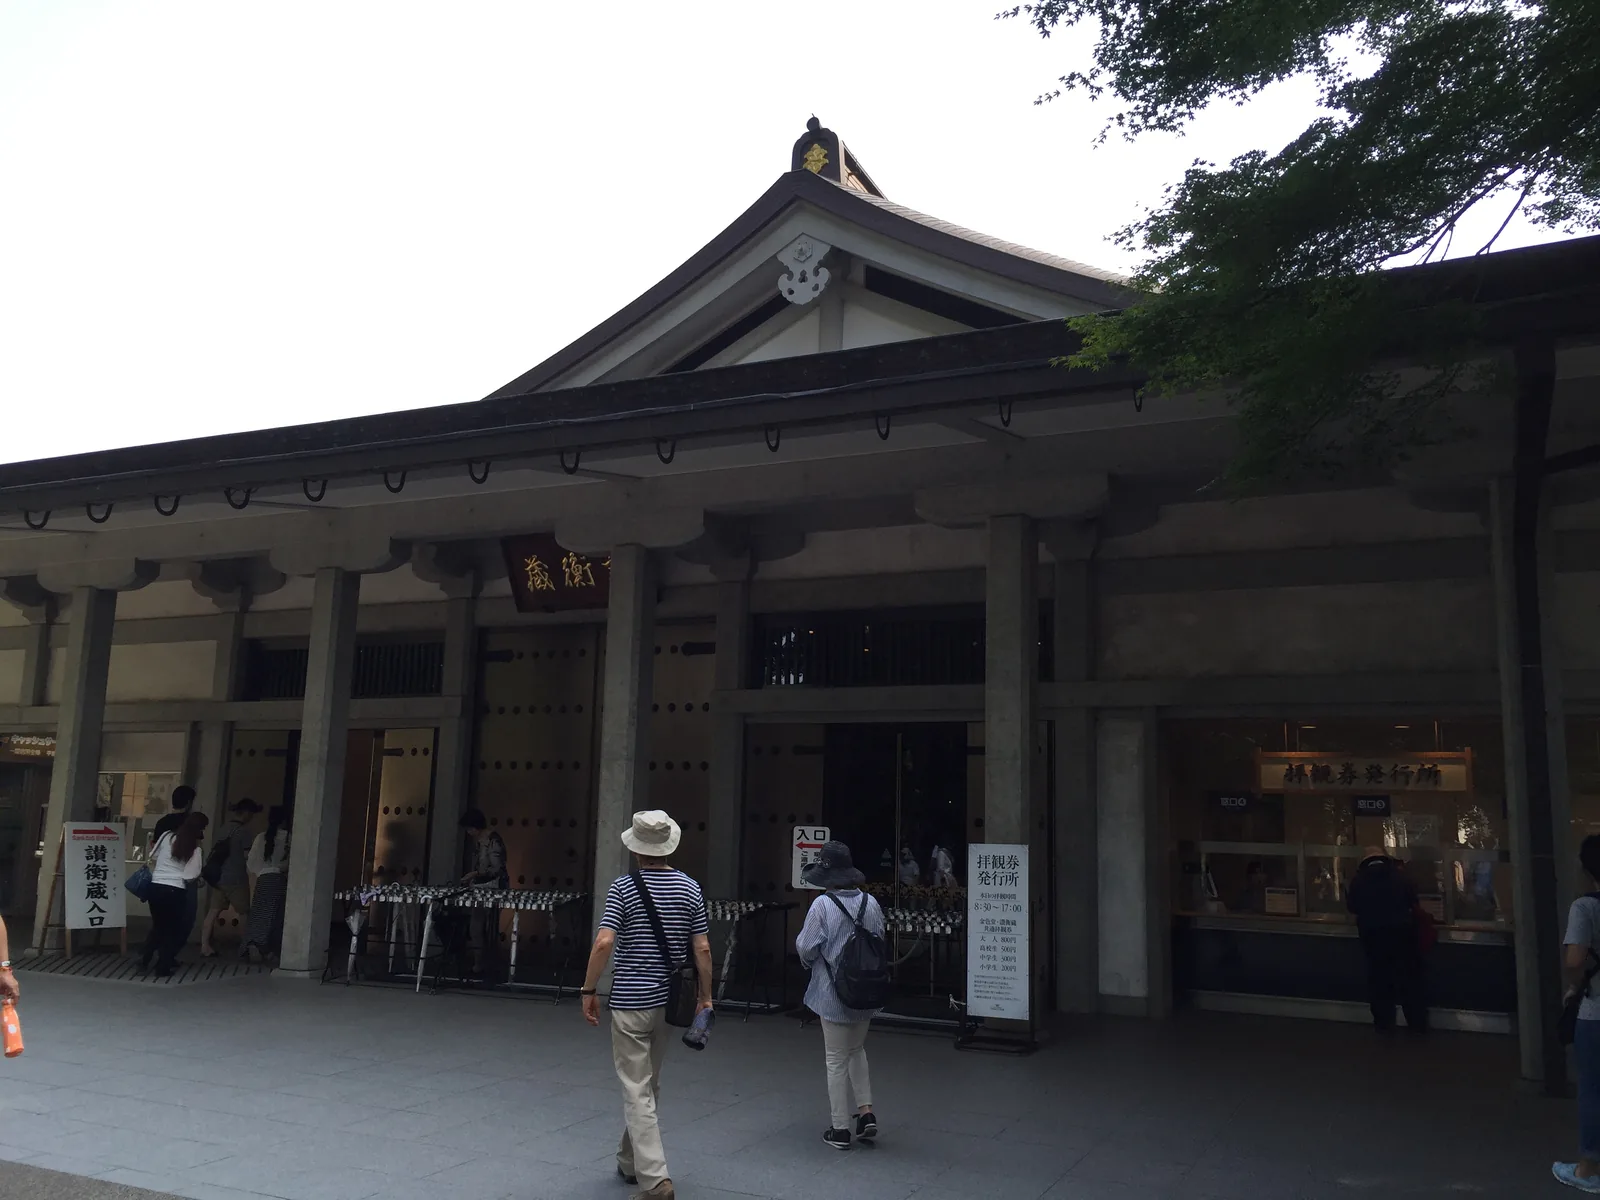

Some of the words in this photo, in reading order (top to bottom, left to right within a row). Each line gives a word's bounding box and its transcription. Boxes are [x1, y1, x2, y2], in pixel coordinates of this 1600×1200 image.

[1284, 762, 1442, 786] 拝観券発行所
[797, 829, 826, 841] 入口
[977, 854, 1019, 870] 拝観券
[977, 871, 1019, 887] 発行所
[979, 963, 998, 971] 小学生
